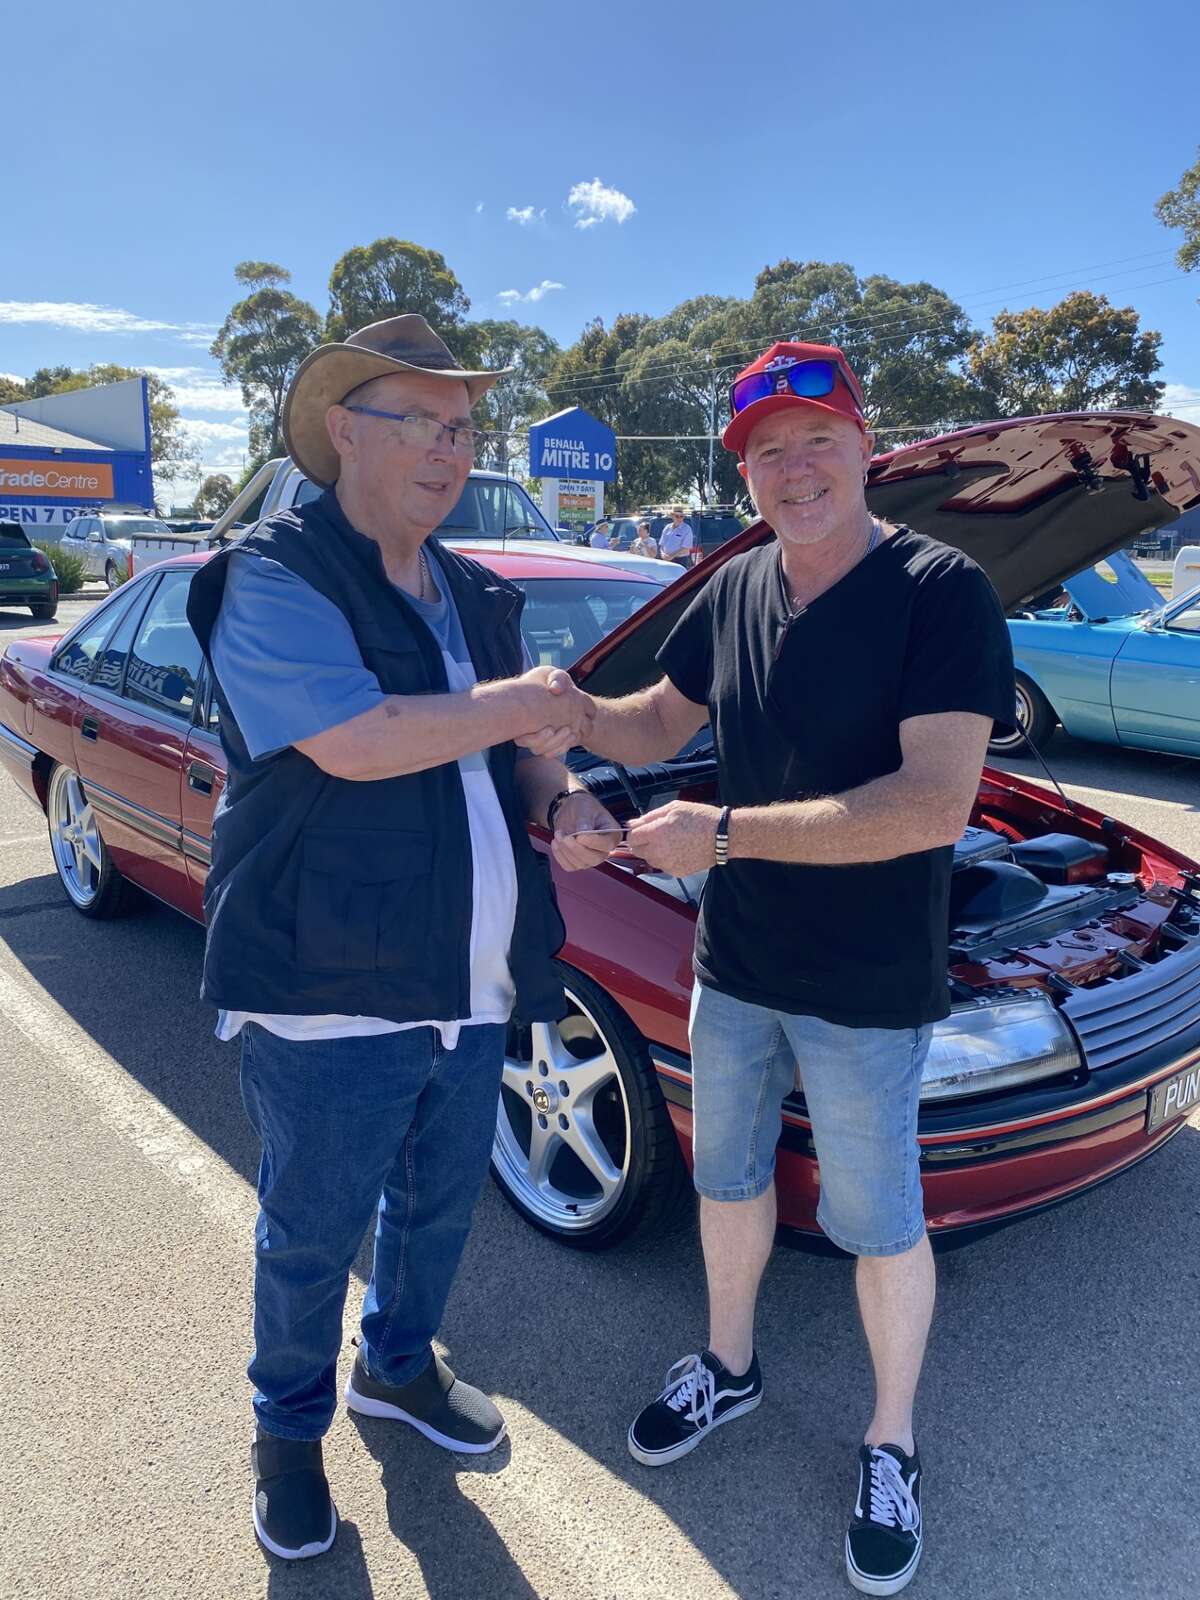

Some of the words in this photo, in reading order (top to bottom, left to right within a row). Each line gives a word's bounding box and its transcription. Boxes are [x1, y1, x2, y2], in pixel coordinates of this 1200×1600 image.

[544, 438, 585, 450] BENALLA
[541, 448, 590, 469] MITRE
[594, 452, 613, 471] 10
[44, 508, 56, 523] 7
